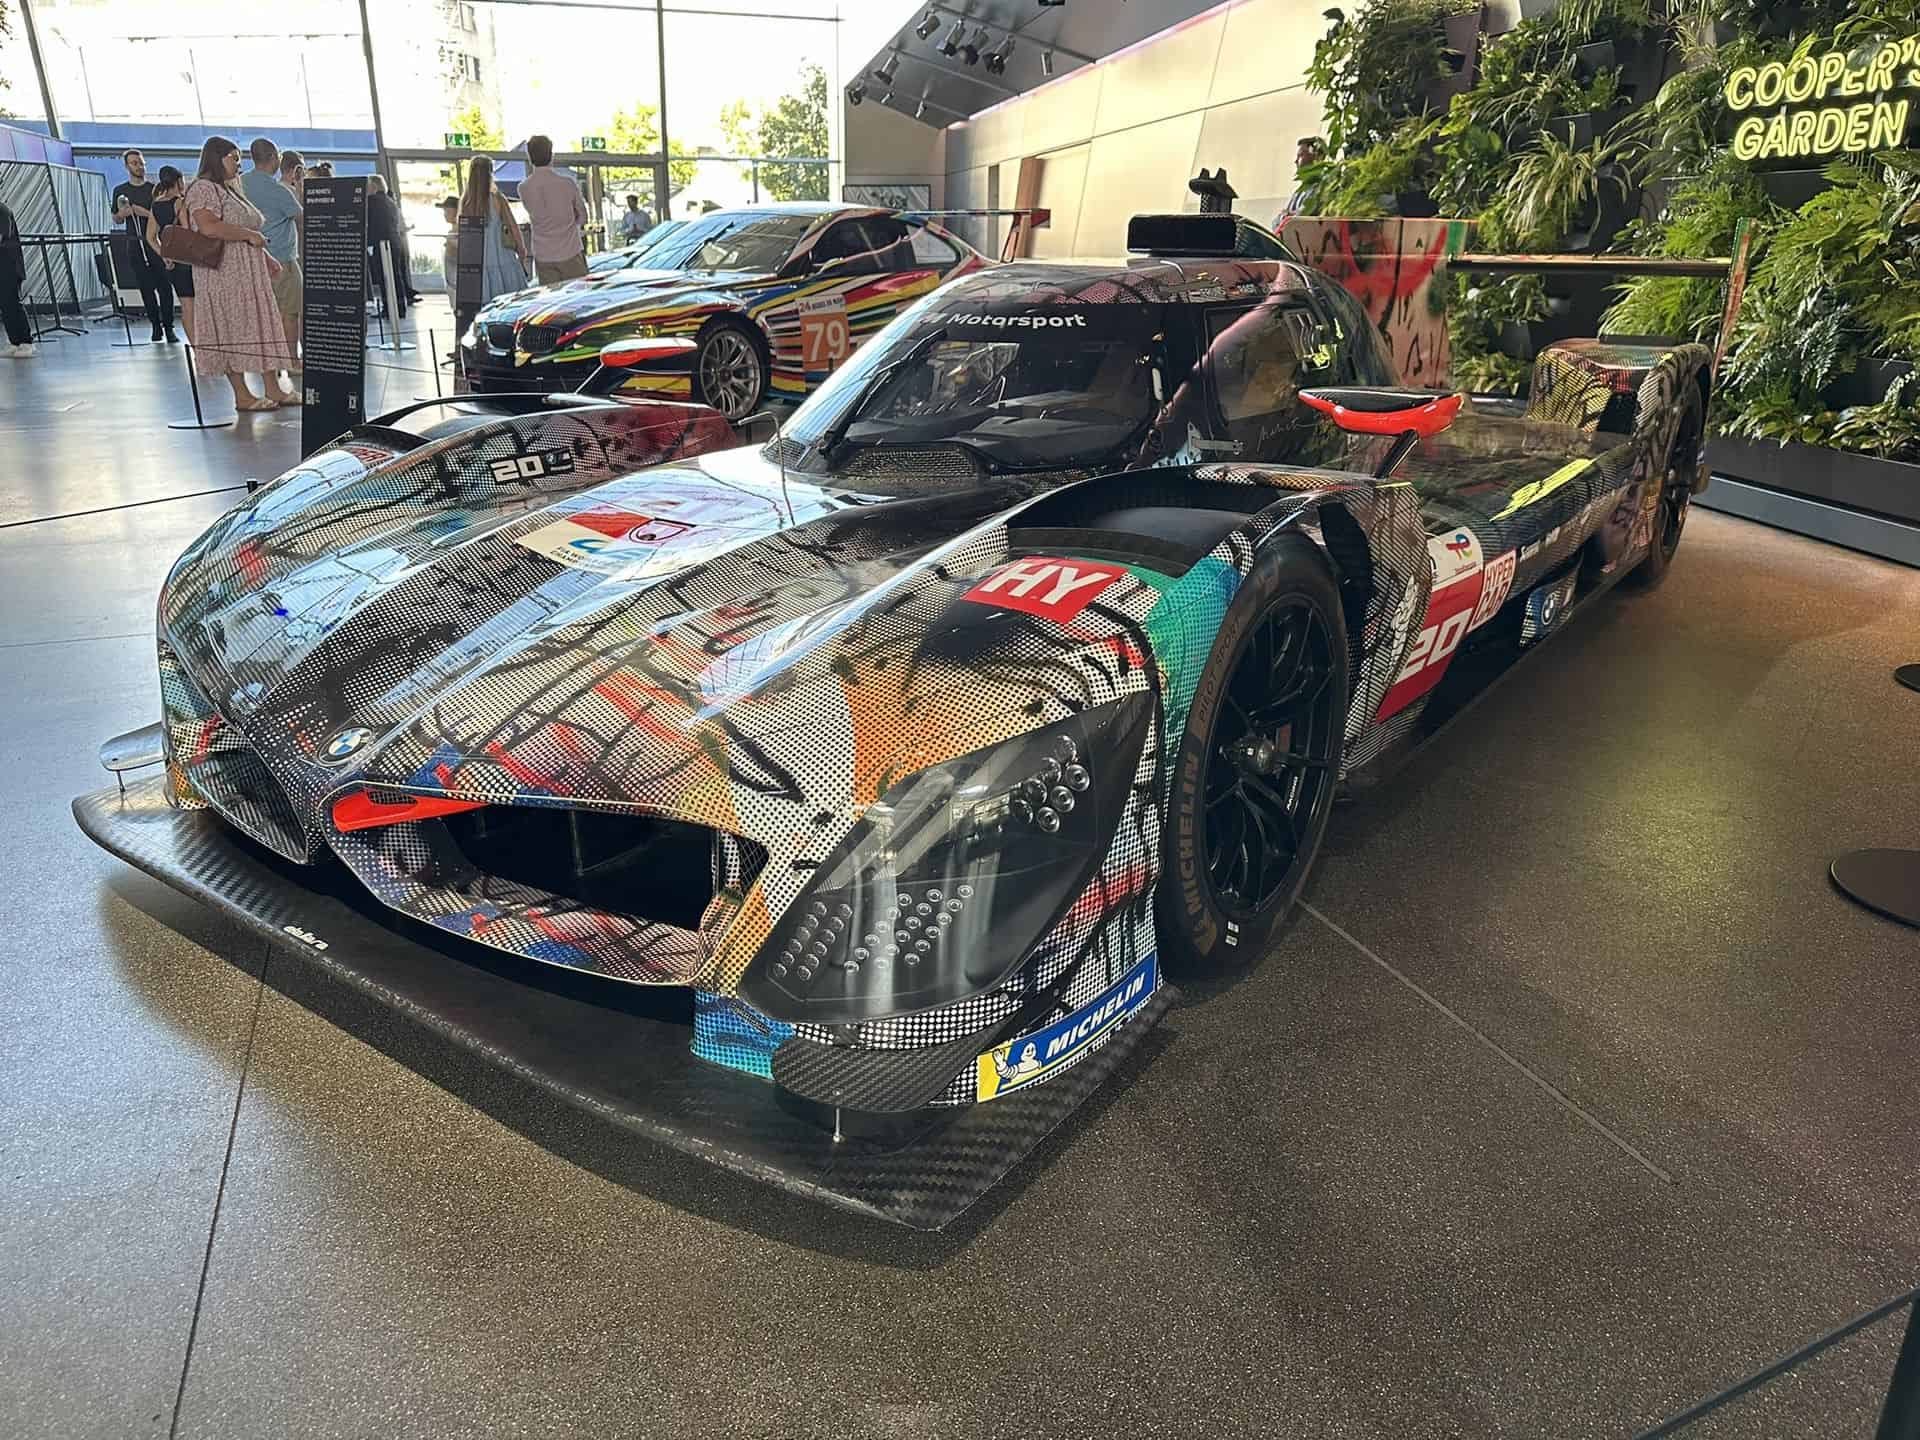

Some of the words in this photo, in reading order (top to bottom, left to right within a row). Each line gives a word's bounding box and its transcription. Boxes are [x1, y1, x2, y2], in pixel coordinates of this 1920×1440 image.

[1734, 100, 1908, 160] GARDEN
[805, 320, 846, 362] 79
[947, 312, 1087, 329] Motorsport
[490, 454, 544, 482] 20
[979, 562, 1112, 606] HY
[1484, 556, 1514, 593] HYPER
[1393, 607, 1474, 685] 20
[1179, 751, 1203, 915] MICHELIN
[1045, 972, 1145, 1060] MICHELIN
